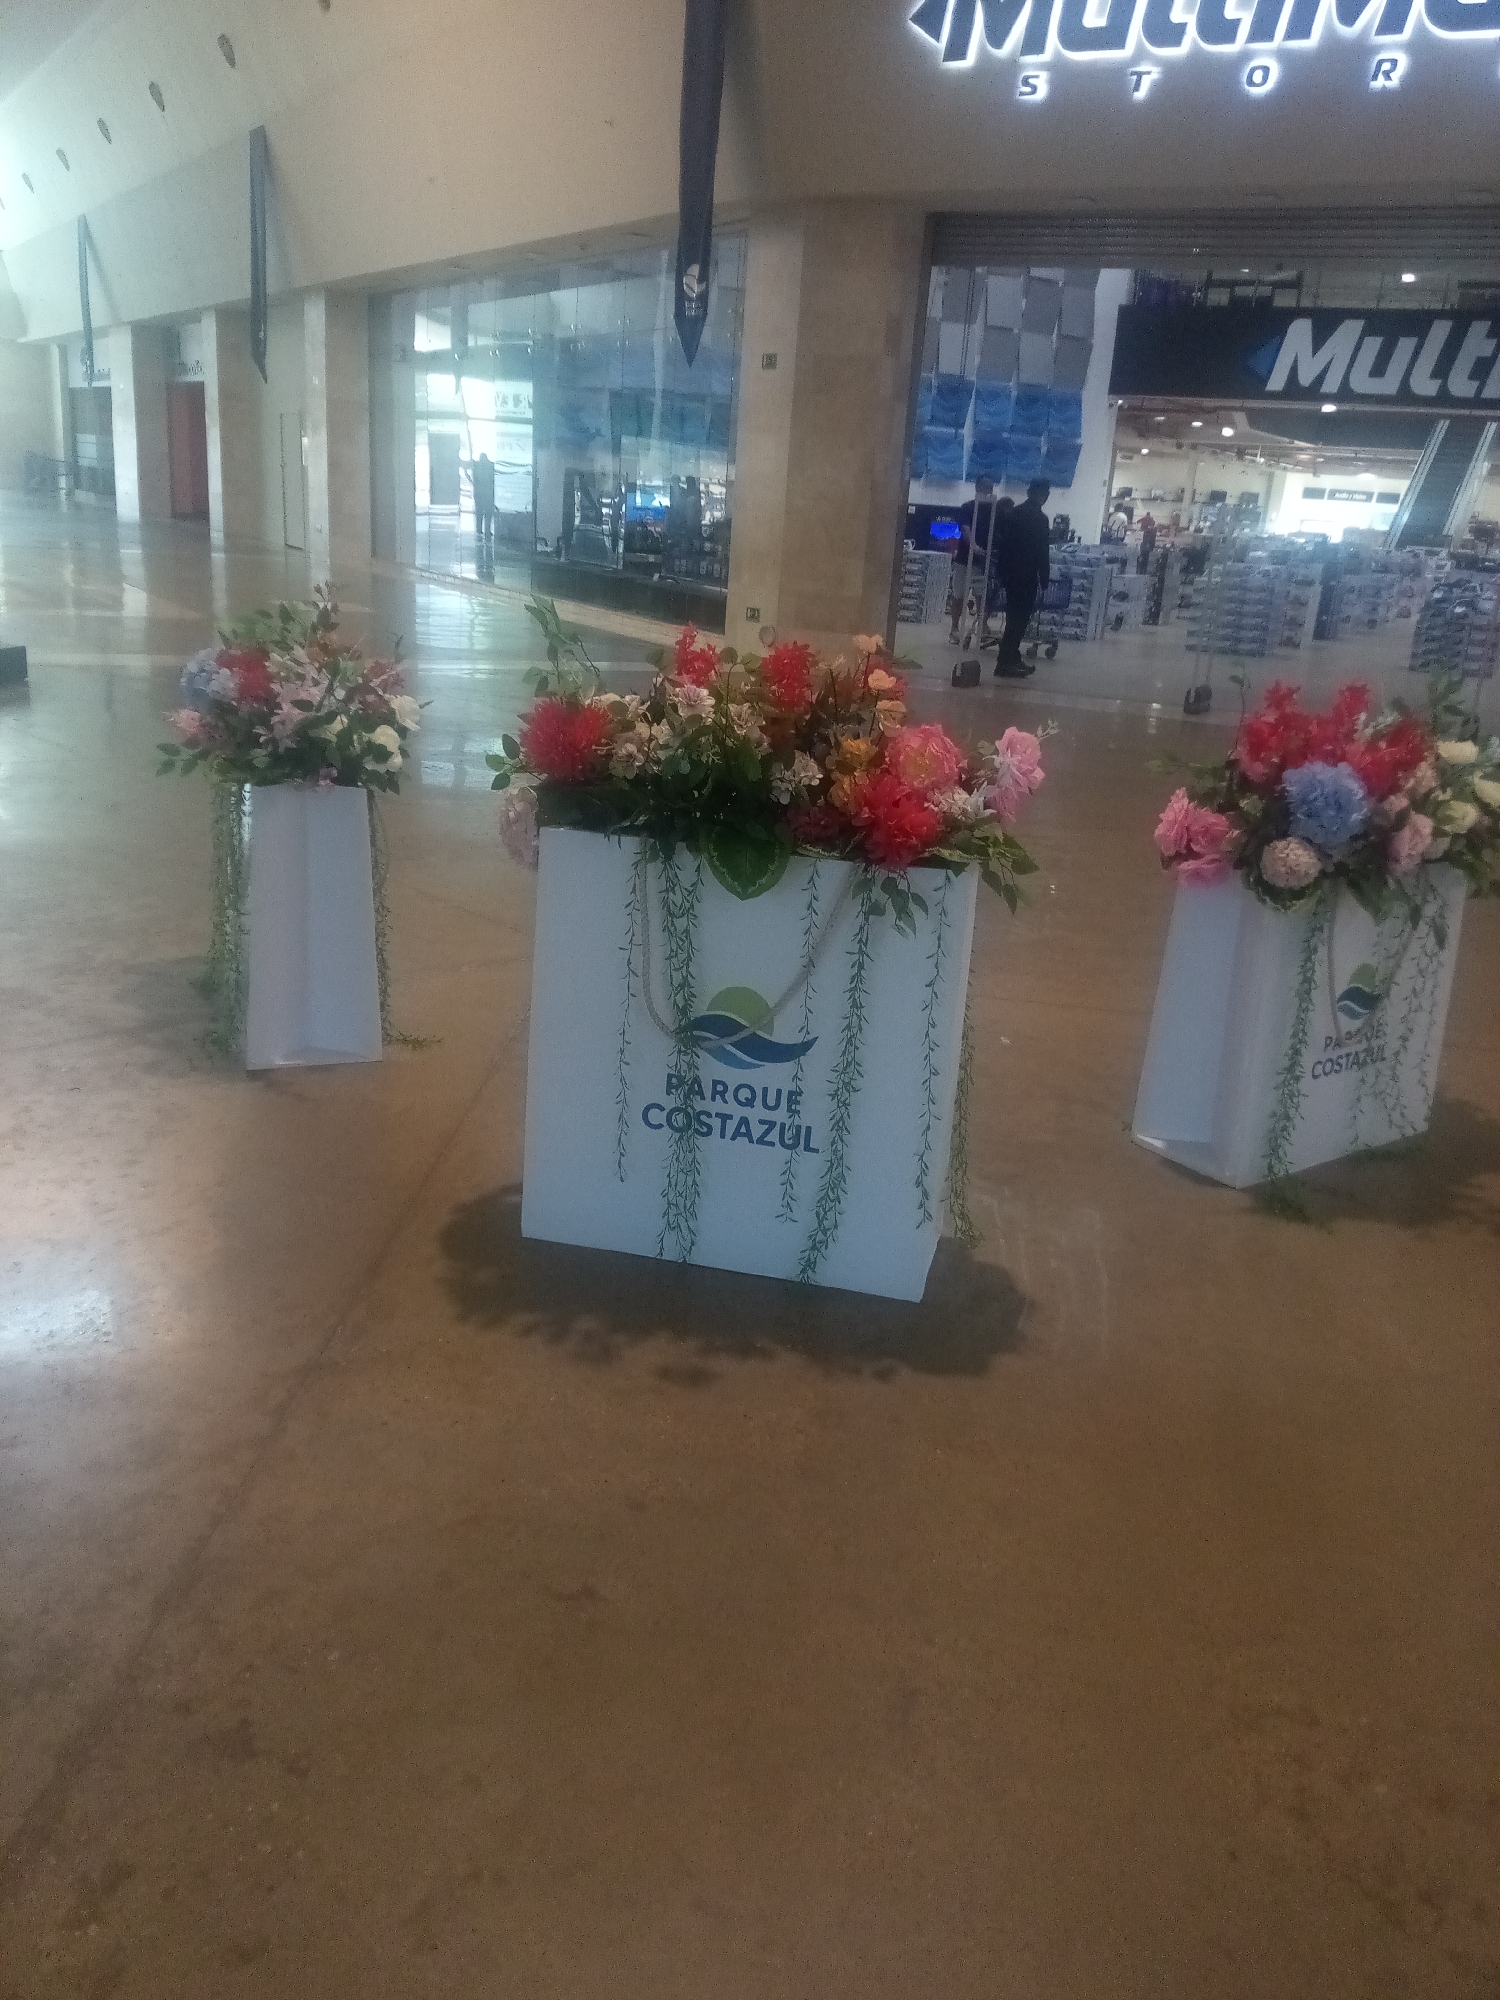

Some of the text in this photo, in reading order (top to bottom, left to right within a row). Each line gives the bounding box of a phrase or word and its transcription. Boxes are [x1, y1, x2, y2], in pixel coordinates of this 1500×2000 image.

[1018, 57, 1399, 97] STOR
[665, 1072, 801, 1114] PARQUE
[642, 1103, 820, 1154] COSTAZUL
